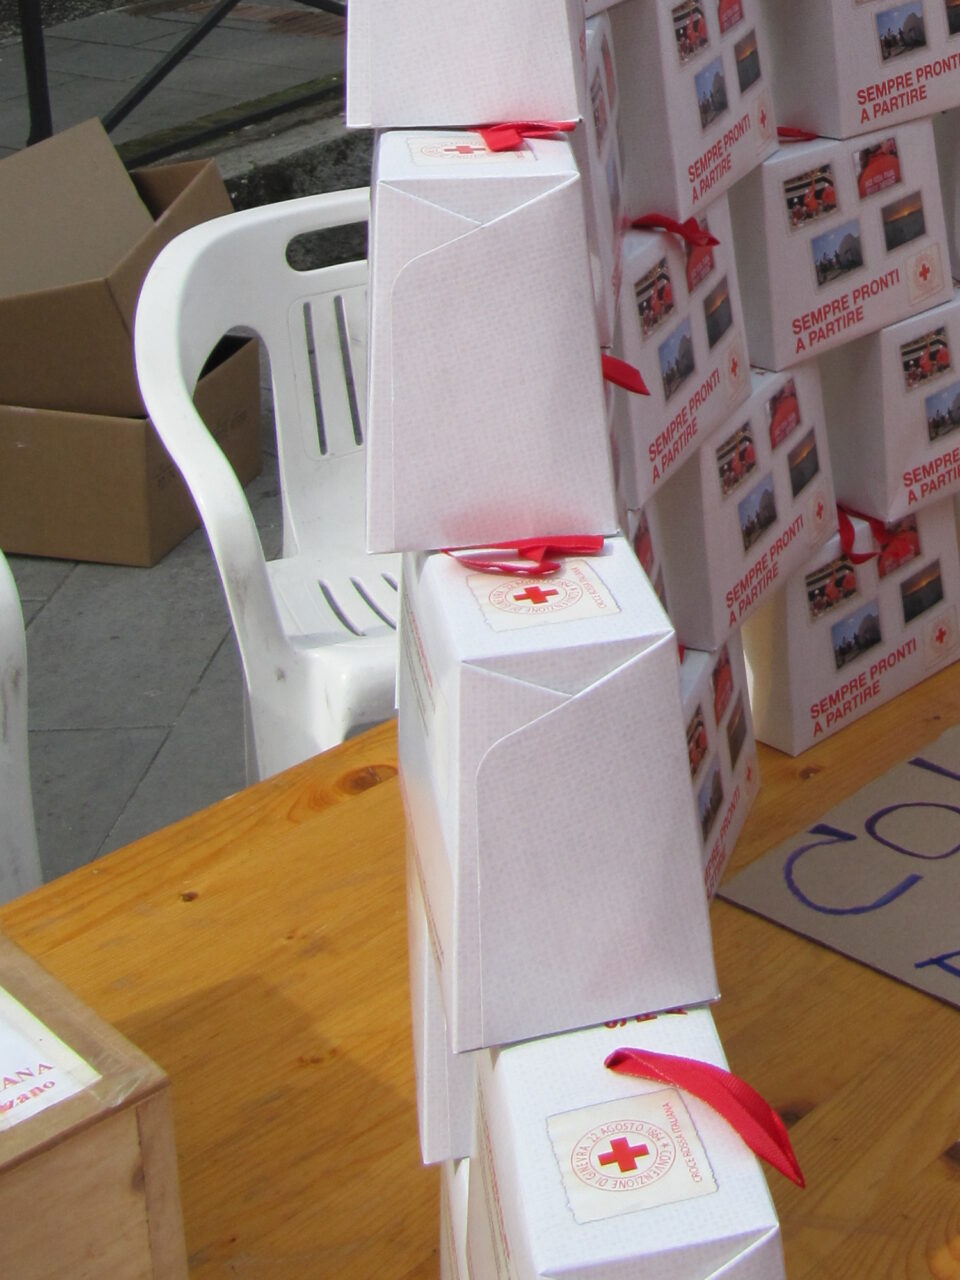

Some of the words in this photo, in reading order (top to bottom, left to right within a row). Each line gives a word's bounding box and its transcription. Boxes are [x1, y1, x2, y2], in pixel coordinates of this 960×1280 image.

[857, 71, 913, 106] SEMPRE
[860, 103, 871, 125] A
[872, 84, 927, 119] PARTIRE
[791, 294, 849, 336] SEMPRE
[852, 269, 900, 307] PRONTI
[795, 333, 807, 353] A
[807, 304, 864, 349] PARTIRE
[903, 447, 960, 489] SEMPRE
[907, 489, 918, 505] A
[810, 672, 869, 721] SEMPRE
[867, 639, 918, 683] PRONTI
[812, 718, 824, 737] A
[825, 681, 881, 728] PARTIRE
